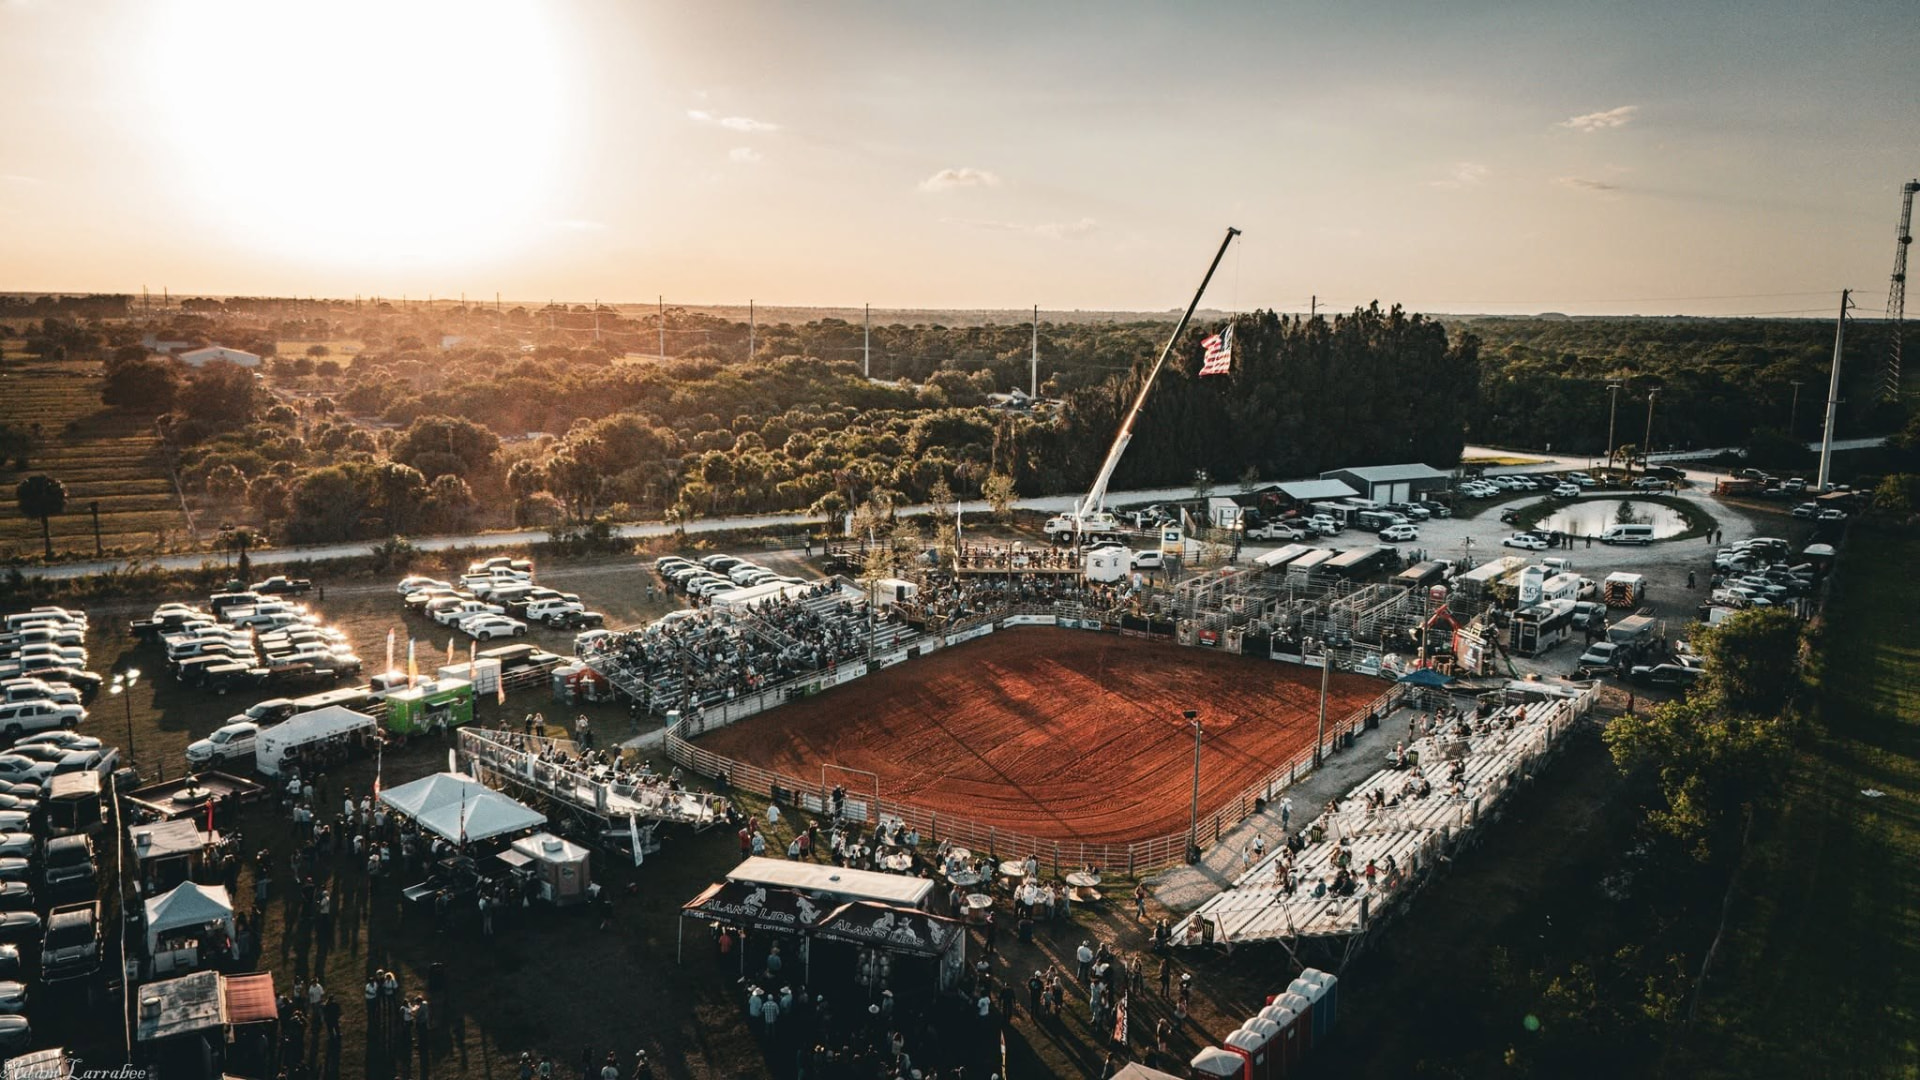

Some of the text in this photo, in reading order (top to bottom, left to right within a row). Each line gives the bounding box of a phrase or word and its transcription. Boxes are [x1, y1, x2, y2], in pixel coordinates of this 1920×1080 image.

[701, 899, 758, 916] ALAN'S
[758, 907, 796, 924] LIDS
[830, 918, 887, 938] ALAN'S
